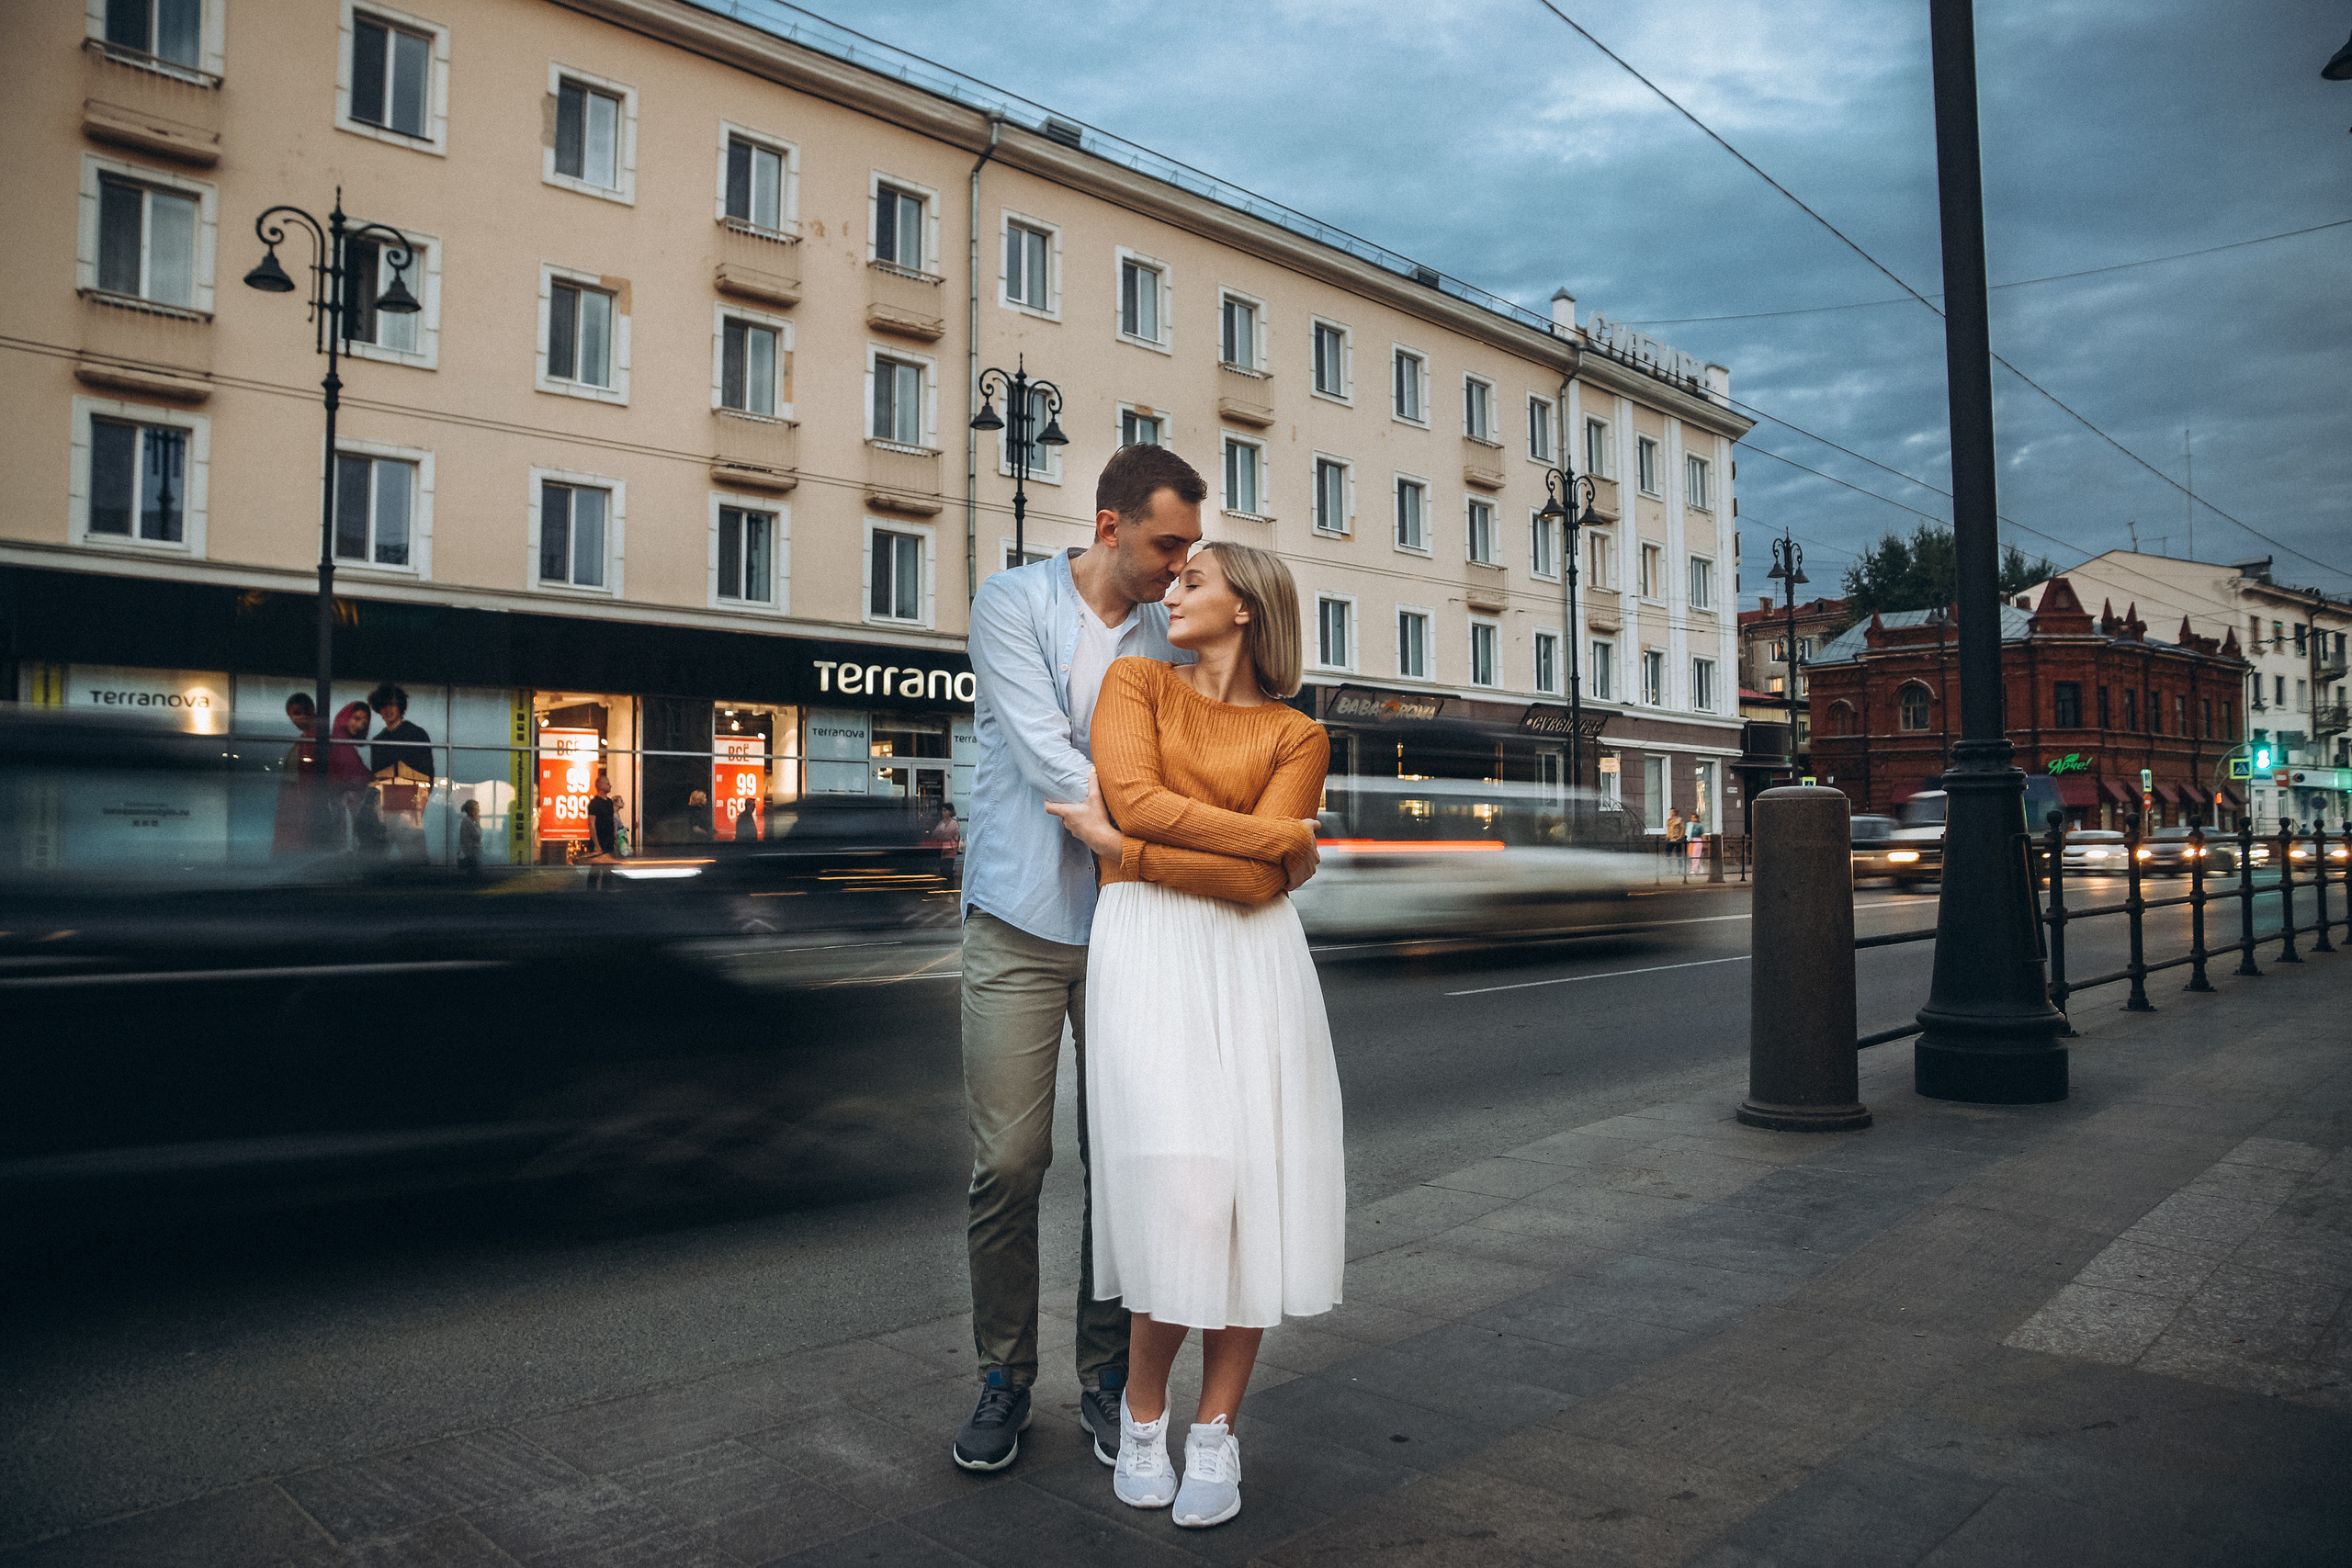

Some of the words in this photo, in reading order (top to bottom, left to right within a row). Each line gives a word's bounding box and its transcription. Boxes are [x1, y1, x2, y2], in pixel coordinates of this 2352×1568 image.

[1587, 310, 1716, 396] СИБИРЬ
[813, 660, 977, 703] Terrano
[90, 690, 210, 708] Terranova
[812, 728, 865, 739] Terranova
[728, 743, 750, 762] ВСЁ
[2048, 756, 2093, 775] Ярче!
[566, 768, 591, 794] 99
[736, 773, 757, 795] 99
[555, 795, 589, 819] 699
